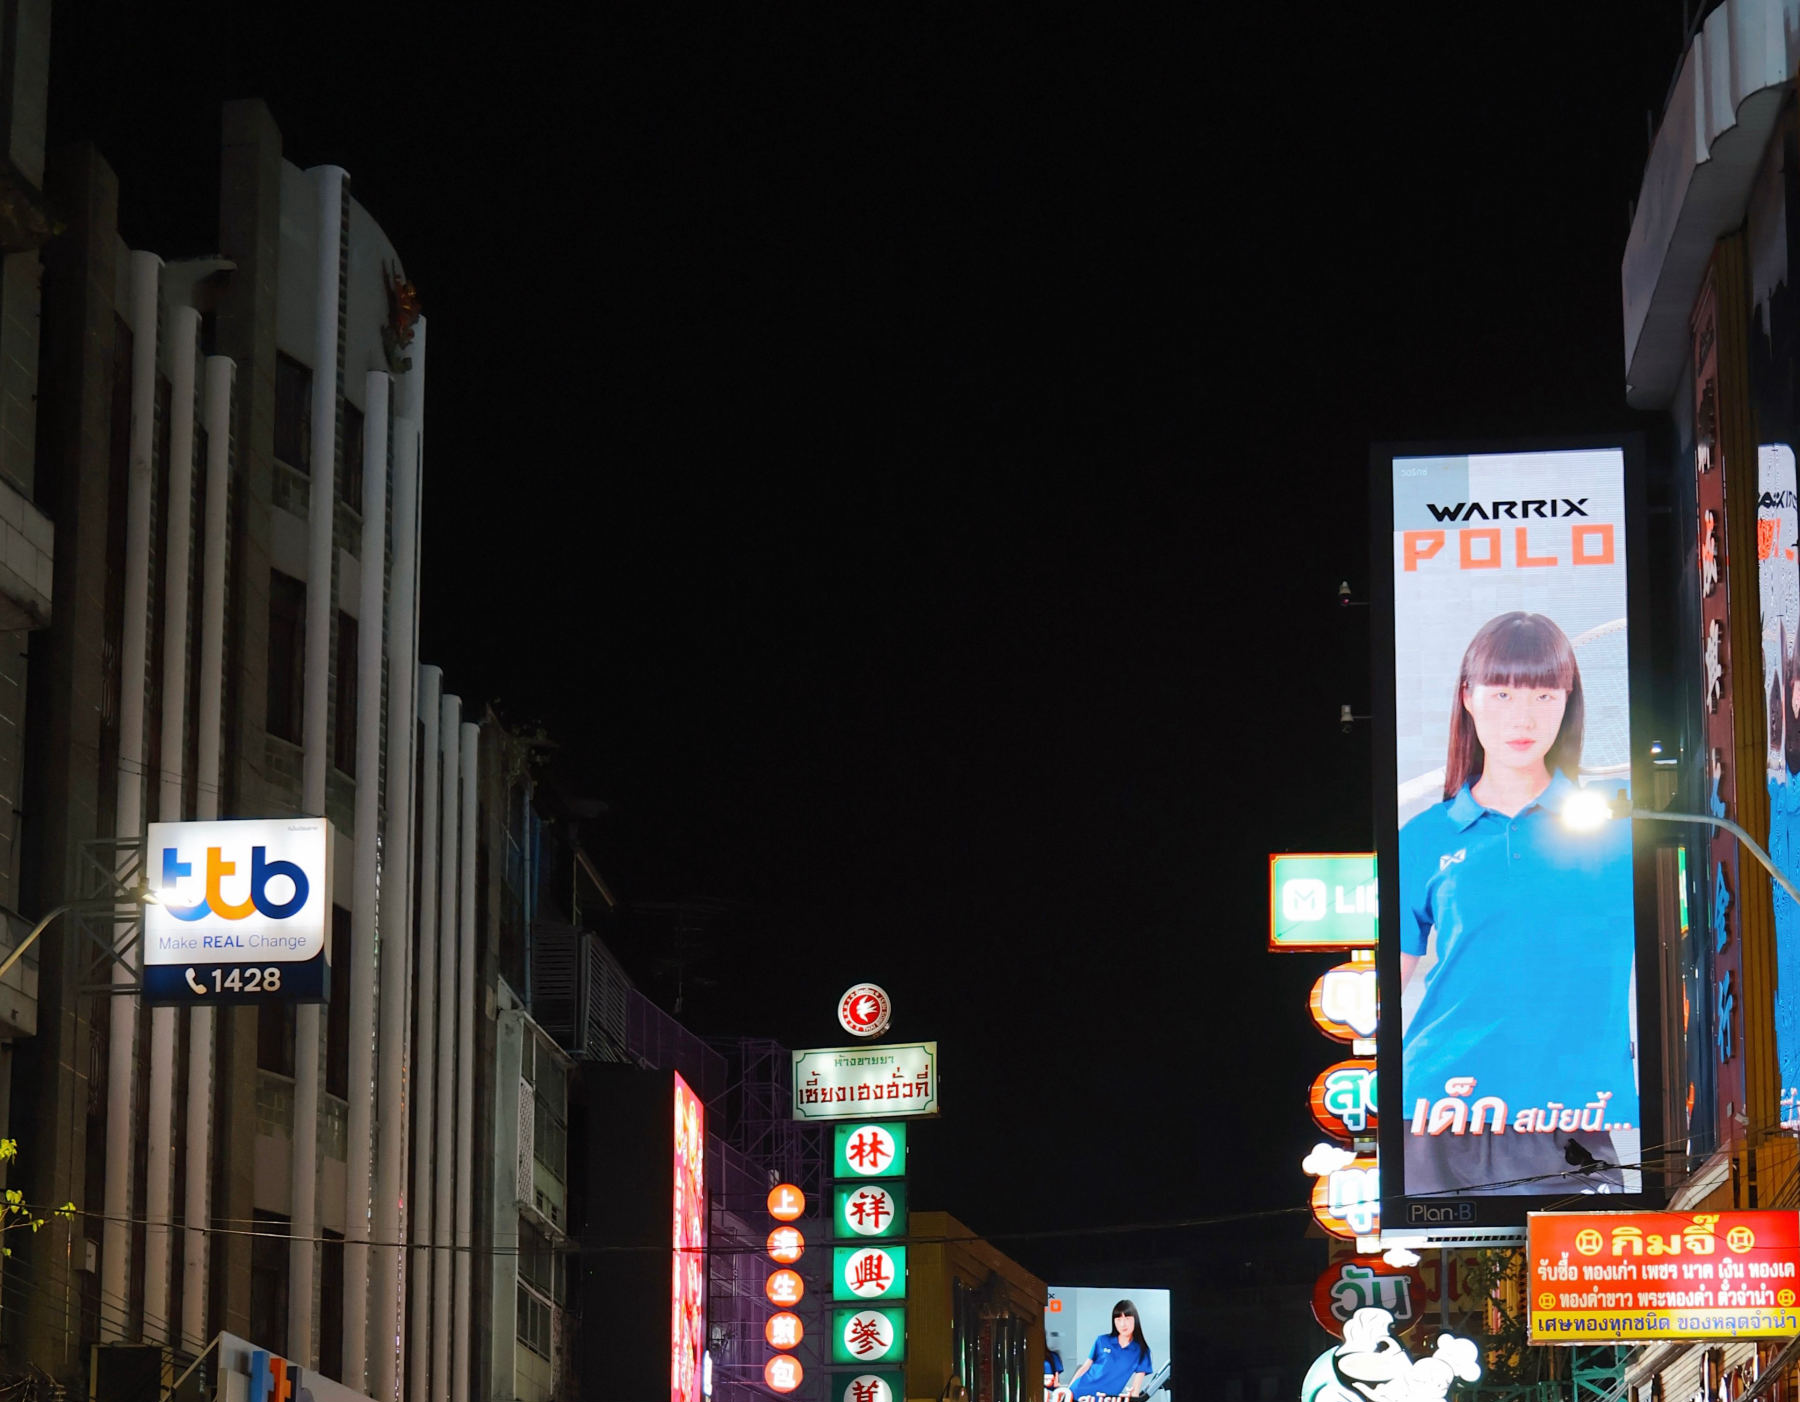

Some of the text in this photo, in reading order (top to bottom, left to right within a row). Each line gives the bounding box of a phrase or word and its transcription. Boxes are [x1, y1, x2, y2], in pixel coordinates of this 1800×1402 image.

[1426, 498, 1589, 522] WARRIX
[1403, 524, 1615, 572] POLO
[162, 846, 310, 922] ttb
[159, 934, 307, 949] Make REAL Change
[211, 967, 281, 993] 1428
[1411, 1077, 1508, 1136] เด็ก
[1538, 1252, 1796, 1281] รับซื้อ ทองเก่า เพชร นาค เงิน ทองเค
[1559, 1285, 1633, 1308] ทองคำขาว
[1638, 1284, 1714, 1307] พระทองคำ
[1538, 1310, 1797, 1337] เศษทองทุกชนิด ของหลุดจำนำ
